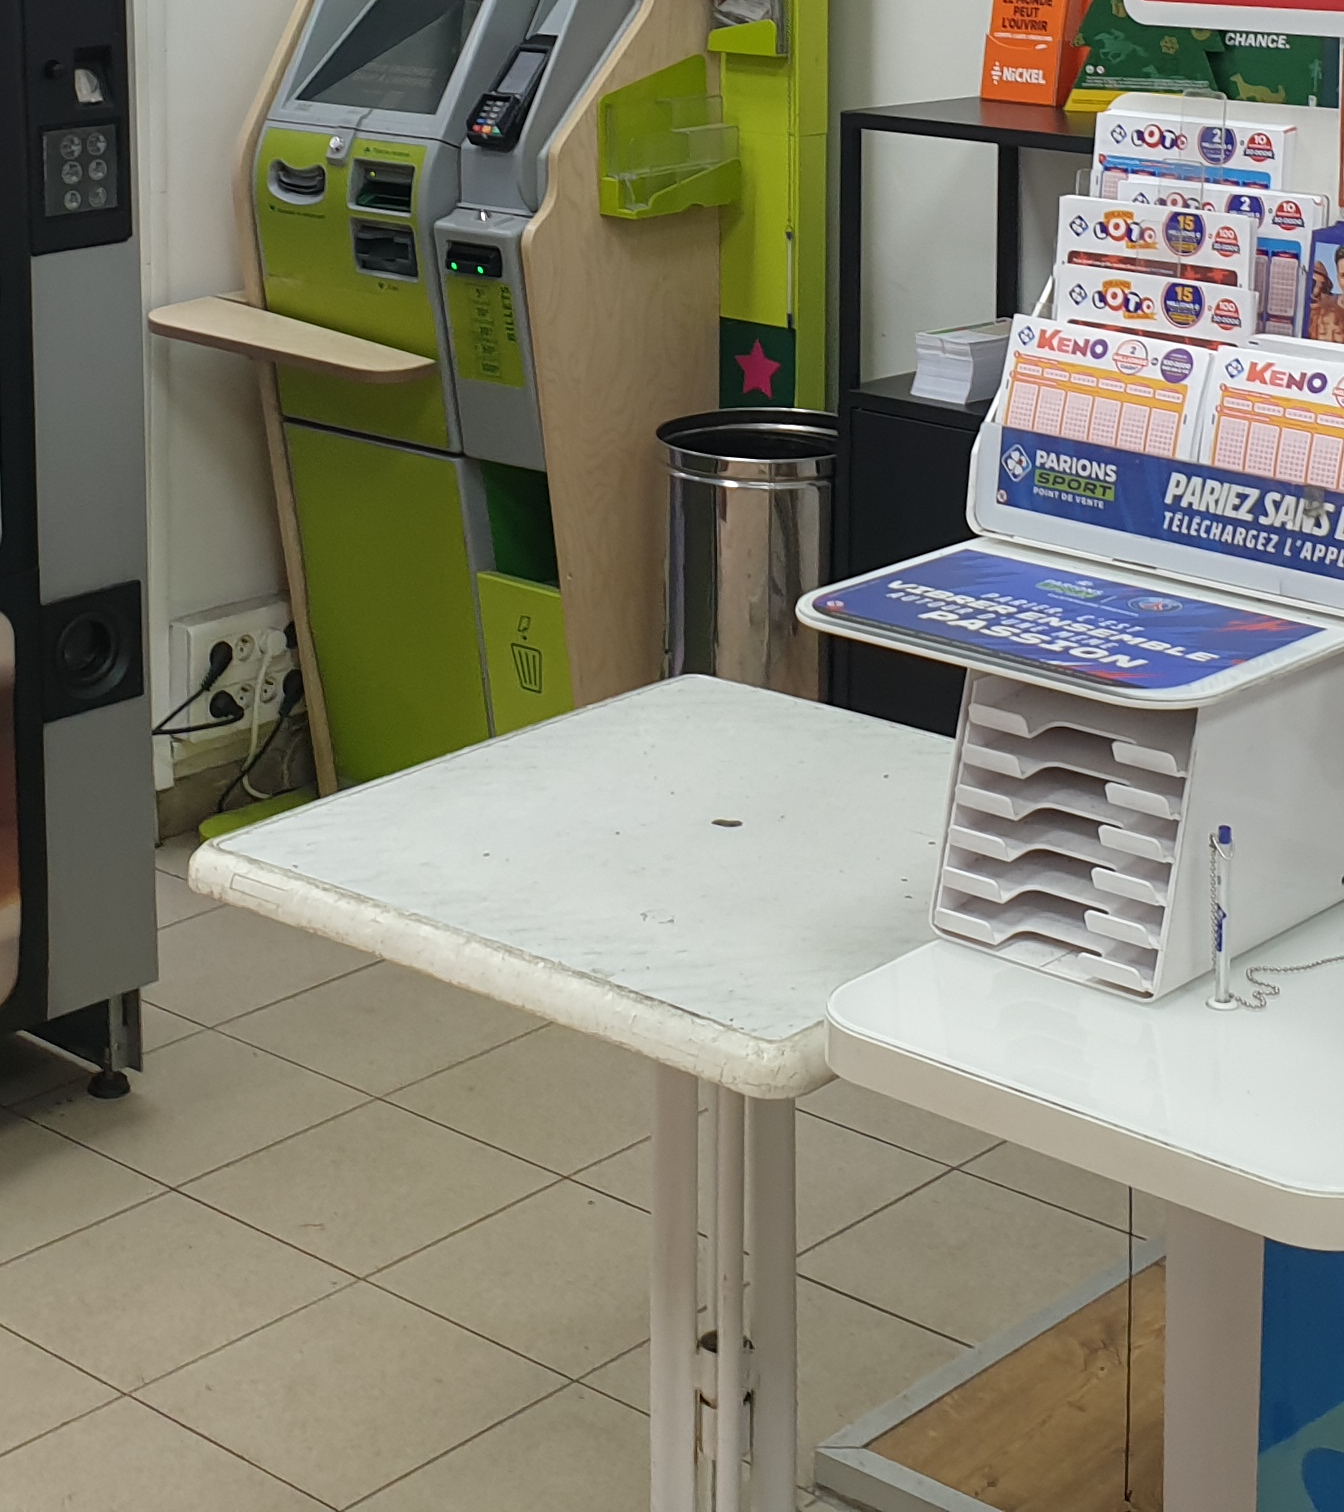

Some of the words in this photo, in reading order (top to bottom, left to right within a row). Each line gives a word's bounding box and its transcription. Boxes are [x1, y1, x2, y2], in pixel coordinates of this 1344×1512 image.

[1013, 6, 1040, 19] PEUT
[1225, 32, 1291, 50] CHANCE.
[1131, 123, 1188, 150] LOTO
[1093, 218, 1156, 244] LOTO
[1092, 286, 1156, 314] LOTO
[1036, 327, 1108, 360] KENO
[1246, 361, 1328, 394] KENO
[1035, 450, 1118, 482] PARIONS
[1164, 471, 1261, 521] PARIEZ
[1263, 489, 1337, 535] SANS
[1162, 510, 1281, 555] TÉLÉCHARGEZ
[917, 609, 1149, 669] PASSION
